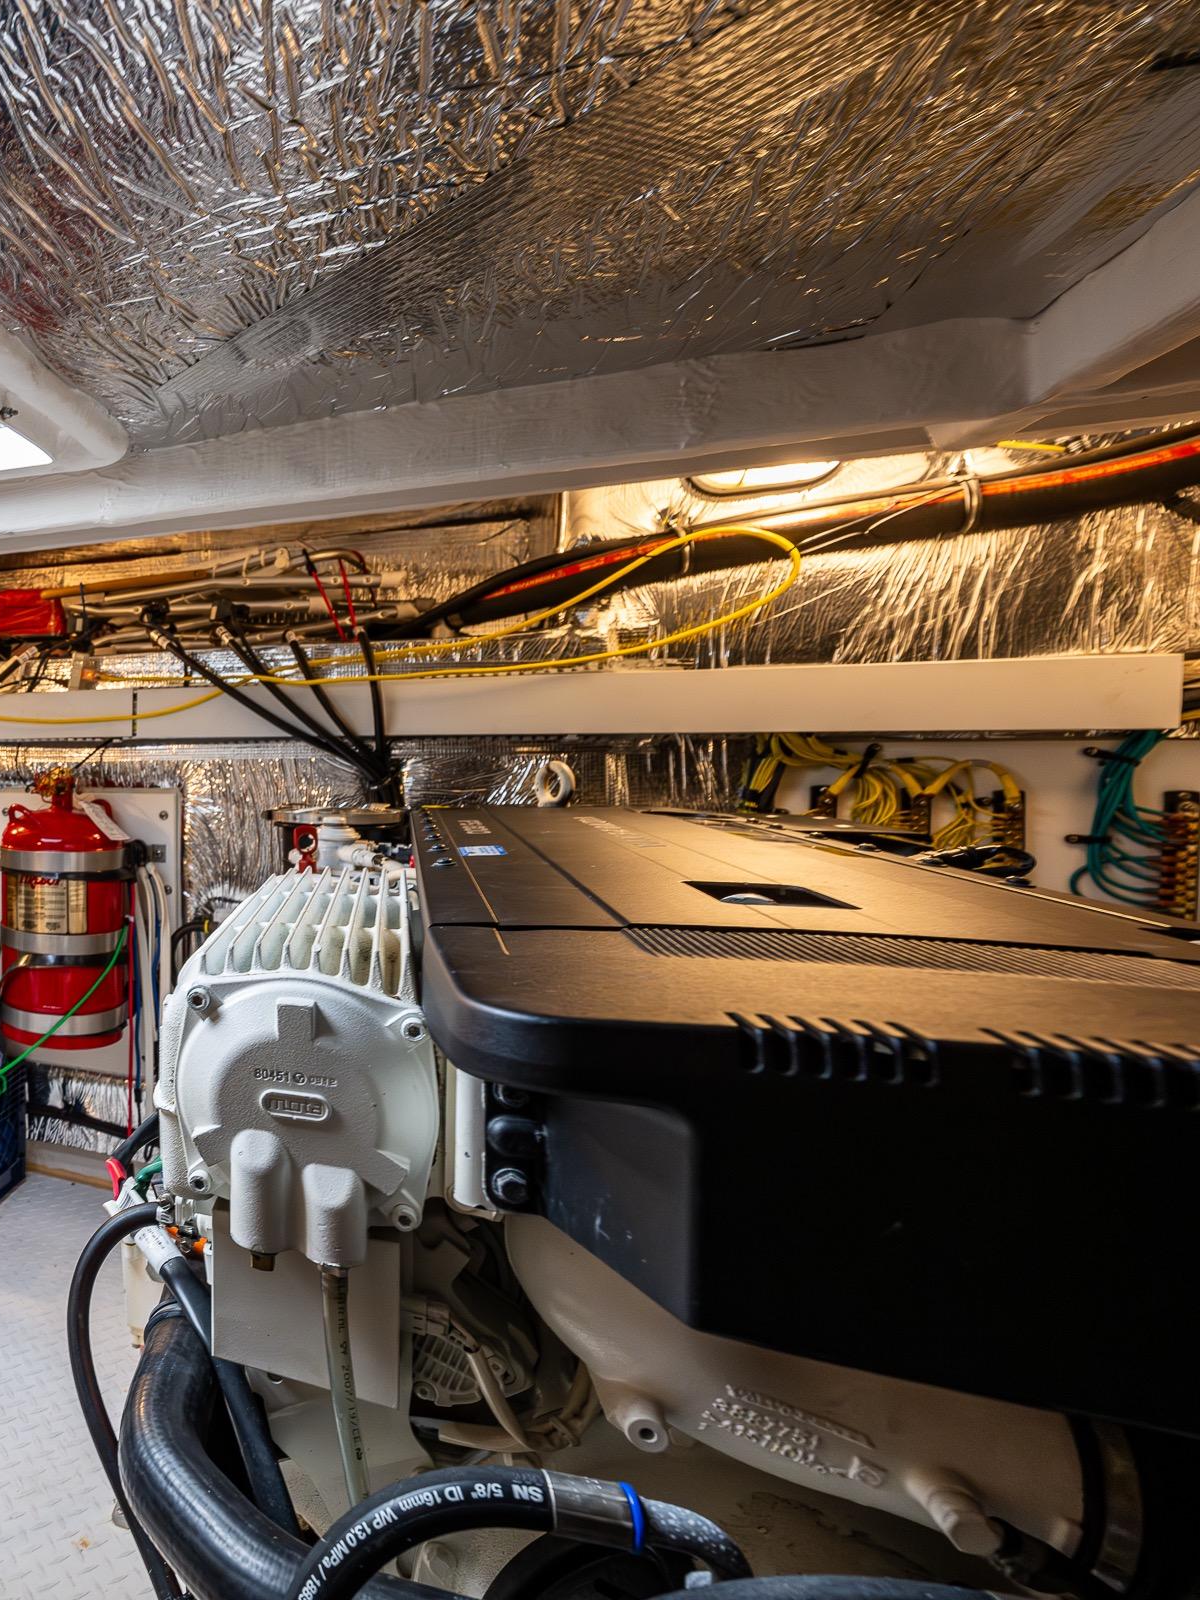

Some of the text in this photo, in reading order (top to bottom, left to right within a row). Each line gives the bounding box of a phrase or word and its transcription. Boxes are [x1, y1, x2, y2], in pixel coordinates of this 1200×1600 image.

[398, 1489, 442, 1512] 16mm
[444, 1485, 465, 1502] ID
[471, 1482, 504, 1499] 5/8"
[511, 1484, 544, 1502] SN
[372, 1506, 399, 1530] WP
[322, 1544, 350, 1568] MPa
